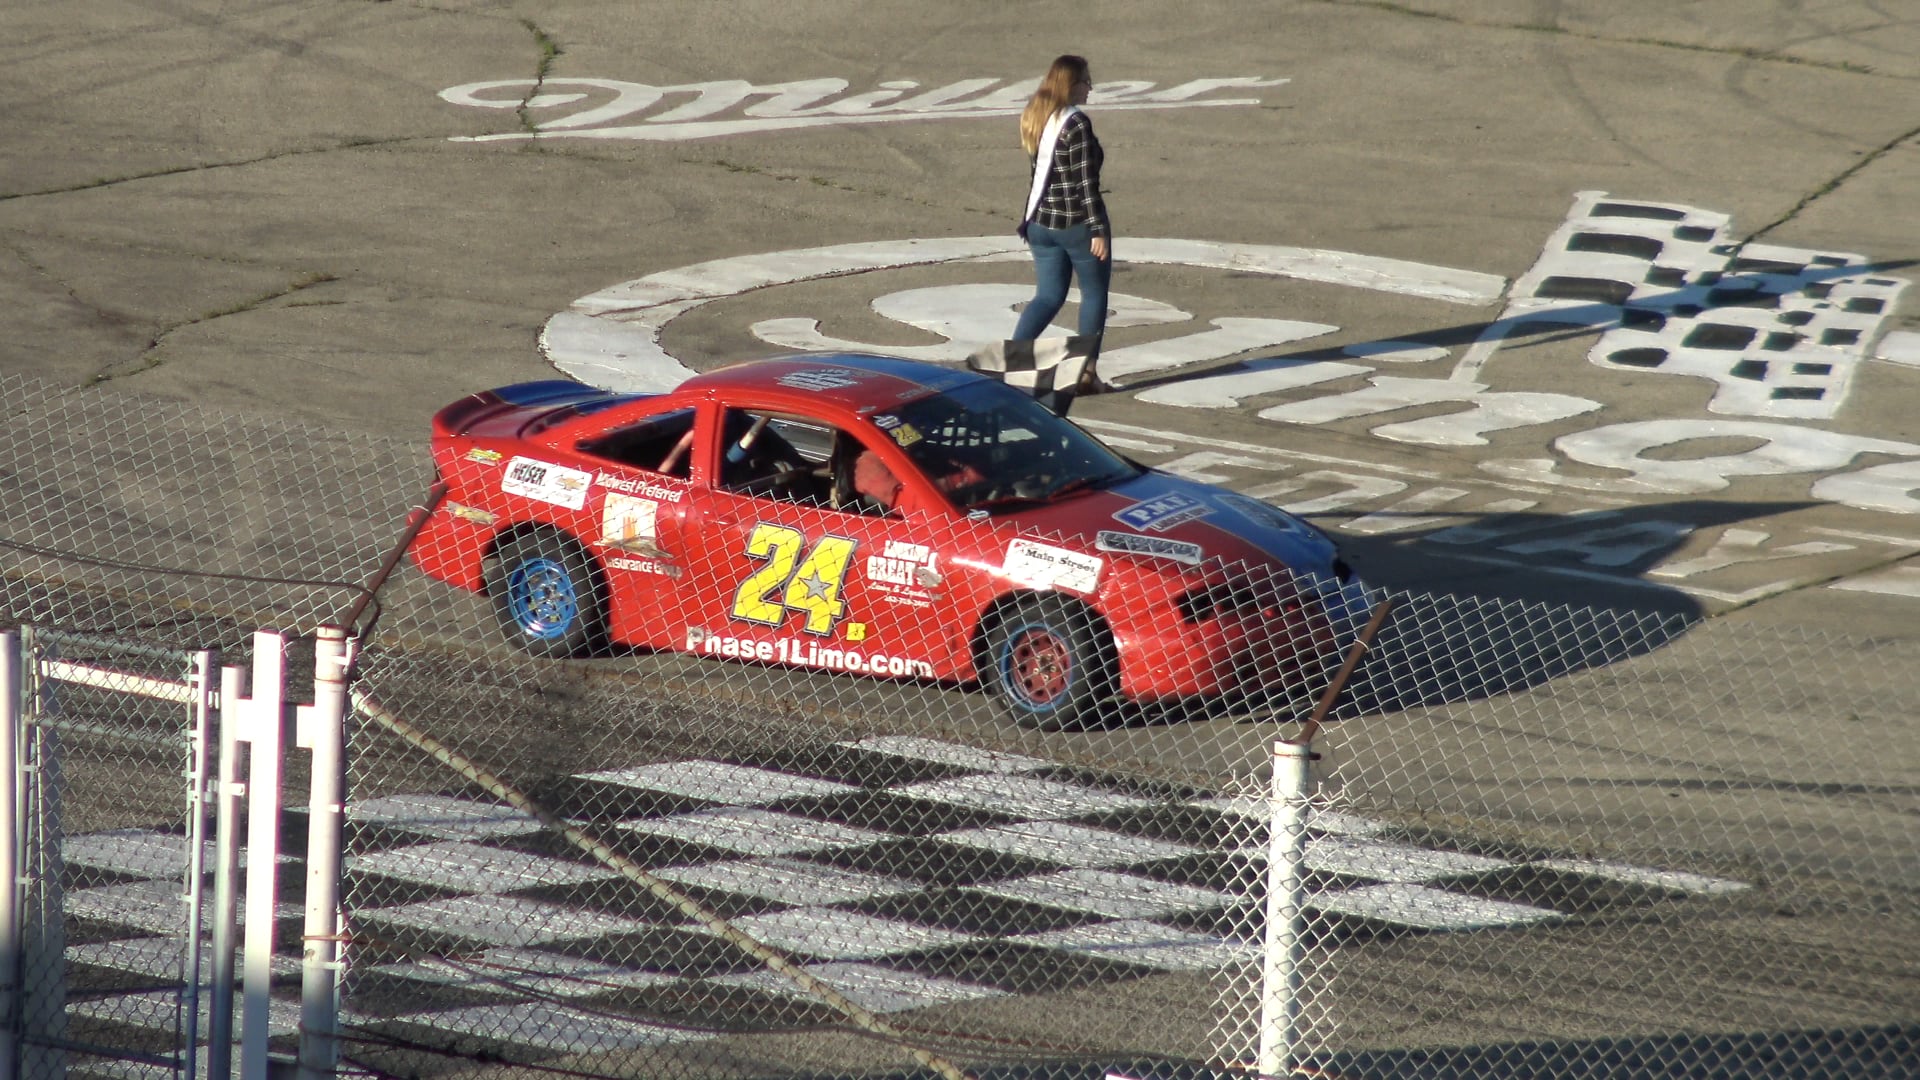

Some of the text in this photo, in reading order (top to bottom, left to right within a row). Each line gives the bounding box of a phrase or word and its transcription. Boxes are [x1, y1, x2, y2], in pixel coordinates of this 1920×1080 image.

[509, 463, 548, 485] HEISER
[634, 480, 684, 502] Preferred
[867, 555, 916, 586] GREAT
[1025, 549, 1096, 572] Main Street
[730, 521, 859, 636] 24
[686, 626, 934, 677] Phase1Limo.com
